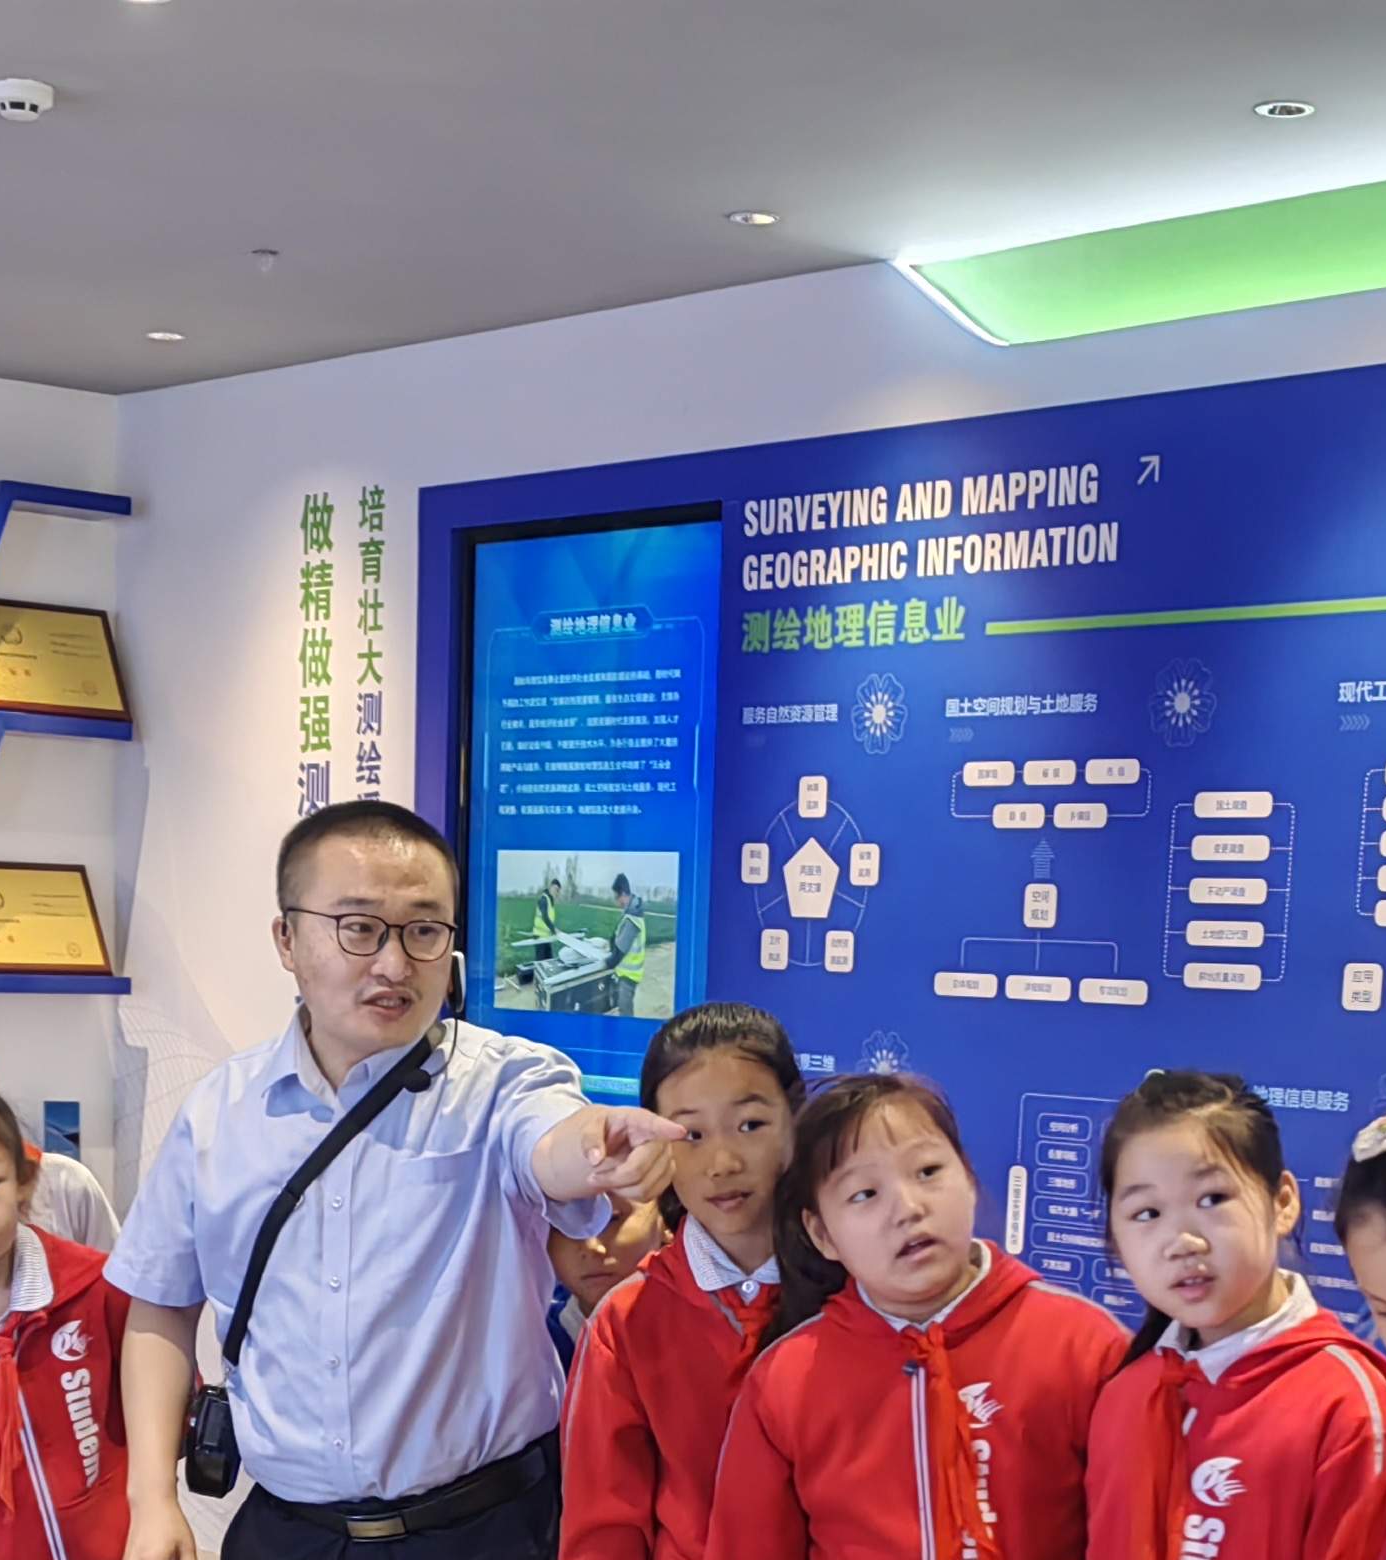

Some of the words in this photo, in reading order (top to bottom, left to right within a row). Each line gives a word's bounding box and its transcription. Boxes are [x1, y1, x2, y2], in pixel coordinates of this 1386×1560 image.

[742, 484, 889, 537] SURVEYING
[894, 479, 953, 524] AND
[960, 462, 1100, 517] MAPPING
[741, 541, 908, 592] GEOGRAPHIC
[916, 522, 1119, 578] INFORMATION
[356, 485, 386, 803] 培育壮大测绘
[549, 613, 637, 636] 测绘地理信息业
[741, 596, 966, 653] 测绘地理信息业
[742, 704, 839, 725] 服务自然资源管理
[945, 693, 1098, 718] 国土空间规划与土地服务
[795, 1052, 835, 1073] 景三维
